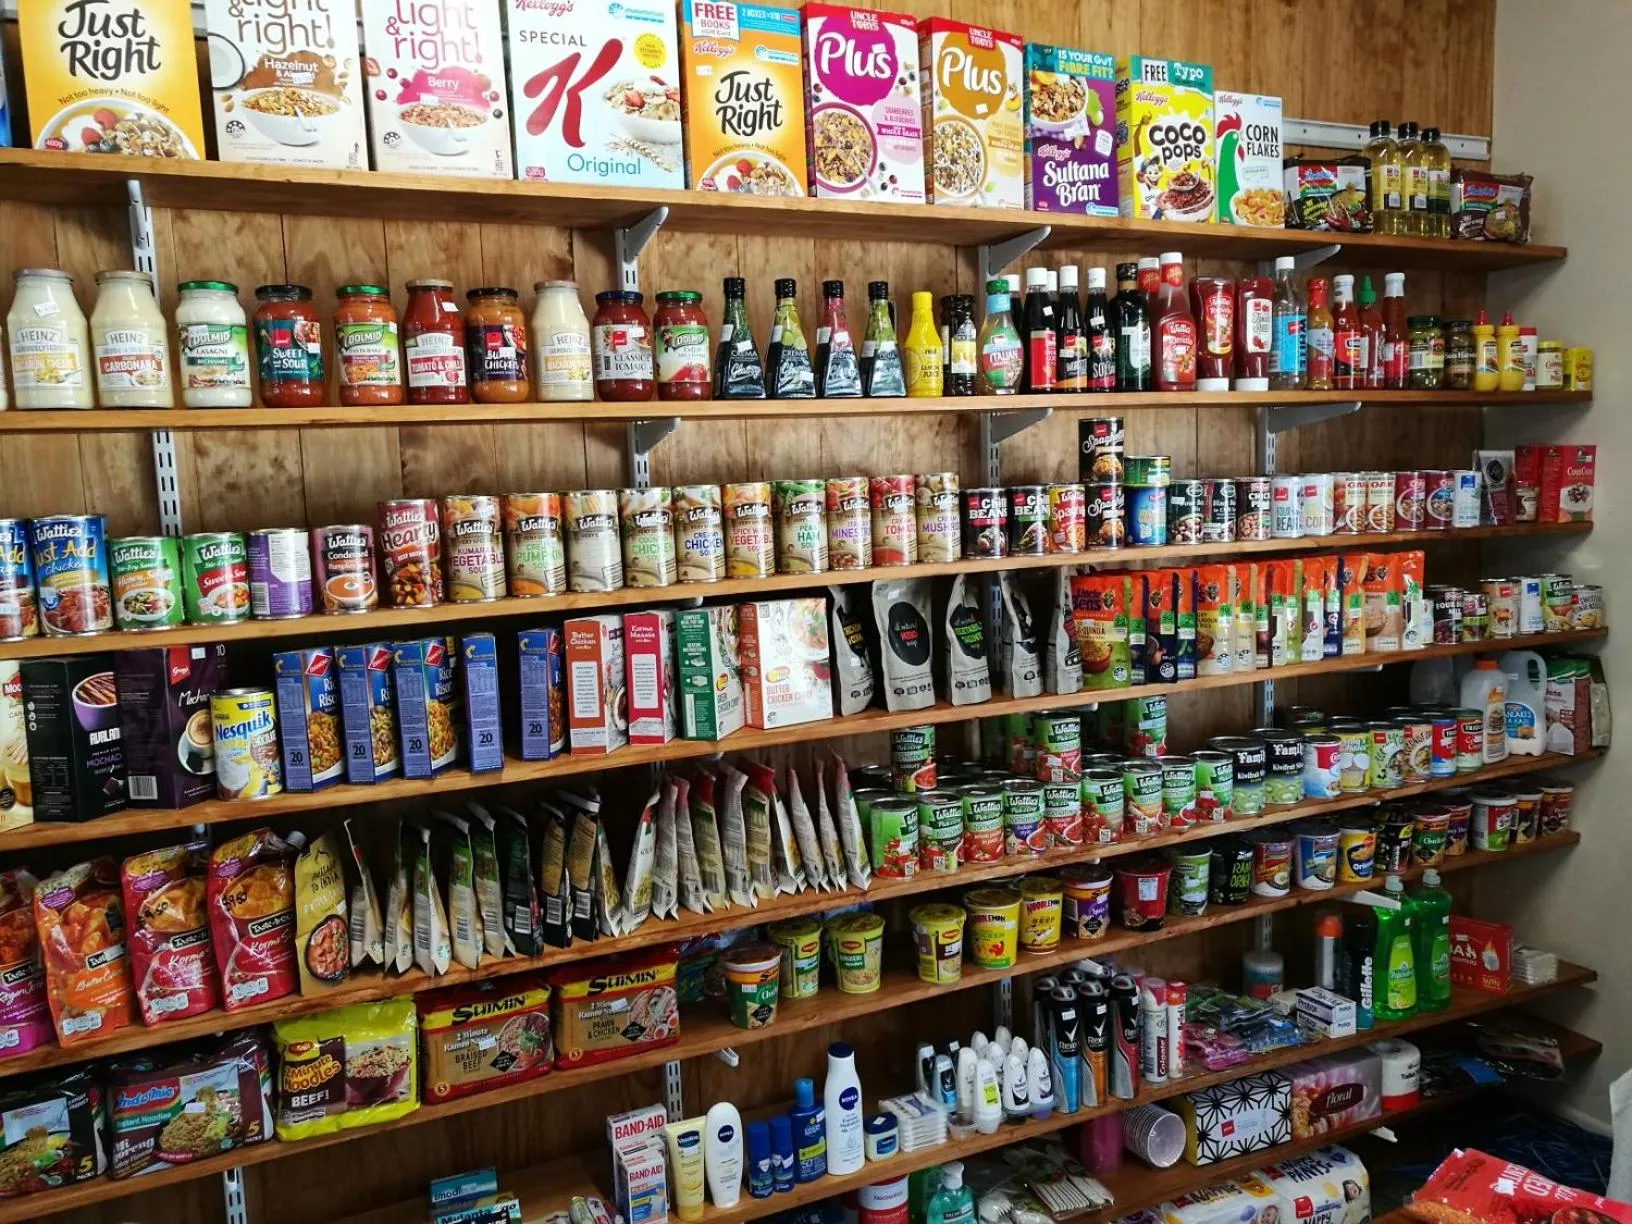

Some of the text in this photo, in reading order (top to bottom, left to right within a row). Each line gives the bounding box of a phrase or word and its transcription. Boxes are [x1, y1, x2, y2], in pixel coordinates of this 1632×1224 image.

[515, 0, 574, 17] Kellogg's
[694, 2, 736, 20] FREE
[58, 0, 146, 39] Just
[700, 19, 731, 29] BOOKS
[851, 11, 878, 23] UNCLE
[238, 13, 335, 55] right!
[519, 30, 588, 47] SPECIAL
[970, 28, 992, 39] UNCLE
[385, 16, 483, 70] & right!
[694, 41, 734, 57] Kellogg's
[61, 36, 162, 82] Right
[818, 31, 893, 80] Plus
[1067, 51, 1093, 64] YOUR
[265, 58, 319, 72] Hazelnut
[941, 48, 1003, 97] Plus
[1058, 62, 1090, 76] FIBRE
[1174, 63, 1204, 80] Typo
[1144, 64, 1167, 83] FREE
[427, 76, 460, 90] Berry
[715, 70, 774, 105] Just
[523, 38, 624, 148] K
[716, 96, 783, 137] Right
[1246, 123, 1278, 143] CORN
[1247, 140, 1280, 159] FLAKES
[567, 153, 642, 177] Original
[1043, 160, 1109, 188] Sultana
[1056, 181, 1101, 207] Bran
[20, 331, 57, 343] HEINZ
[109, 333, 146, 345] HEINZ
[272, 347, 301, 360] SWEET
[781, 350, 808, 358] CREMA
[386, 512, 425, 527] Wattie's
[969, 509, 1007, 518] BEANS
[456, 521, 494, 536] Wattie's
[520, 518, 558, 533] Wattie's
[579, 515, 614, 530] Wattie's
[37, 524, 82, 541] Wattie's
[381, 520, 437, 551] Hearty
[61, 539, 97, 559] Add
[327, 534, 369, 549] Wattie's
[115, 547, 158, 564] Wattie's
[200, 543, 242, 561] Wattie's
[327, 550, 369, 560] Condensed
[571, 631, 594, 640] Butter
[631, 625, 654, 633] Korma
[570, 638, 596, 646] Chicken
[216, 644, 225, 657] 10
[767, 693, 793, 704] CHICKEN
[214, 711, 273, 742] Nesquik
[529, 724, 542, 735] 20
[409, 739, 422, 752] 20
[479, 732, 493, 745] 20
[291, 752, 303, 764] 20
[354, 744, 366, 758] 20
[1052, 769, 1063, 779] NZ
[1046, 789, 1078, 800] Wattie's
[1100, 830, 1111, 840] NZ
[934, 857, 945, 867] NZ
[1361, 956, 1374, 1009] Gillette
[593, 1026, 621, 1039] CHICKEN
[454, 1049, 488, 1064] BRAISED
[1159, 1039, 1168, 1077] Colgate
[285, 1062, 341, 1091] Noodles
[117, 1086, 176, 1110] Indomie
[291, 1089, 330, 1108] BEEF!
[1326, 1086, 1353, 1107] floral
[248, 1121, 260, 1137] 5
[614, 1114, 665, 1141] BAND-AID
[79, 1157, 93, 1172] 5
[629, 1163, 665, 1182] BAND-AID
[1287, 1159, 1330, 1184] PANTS
